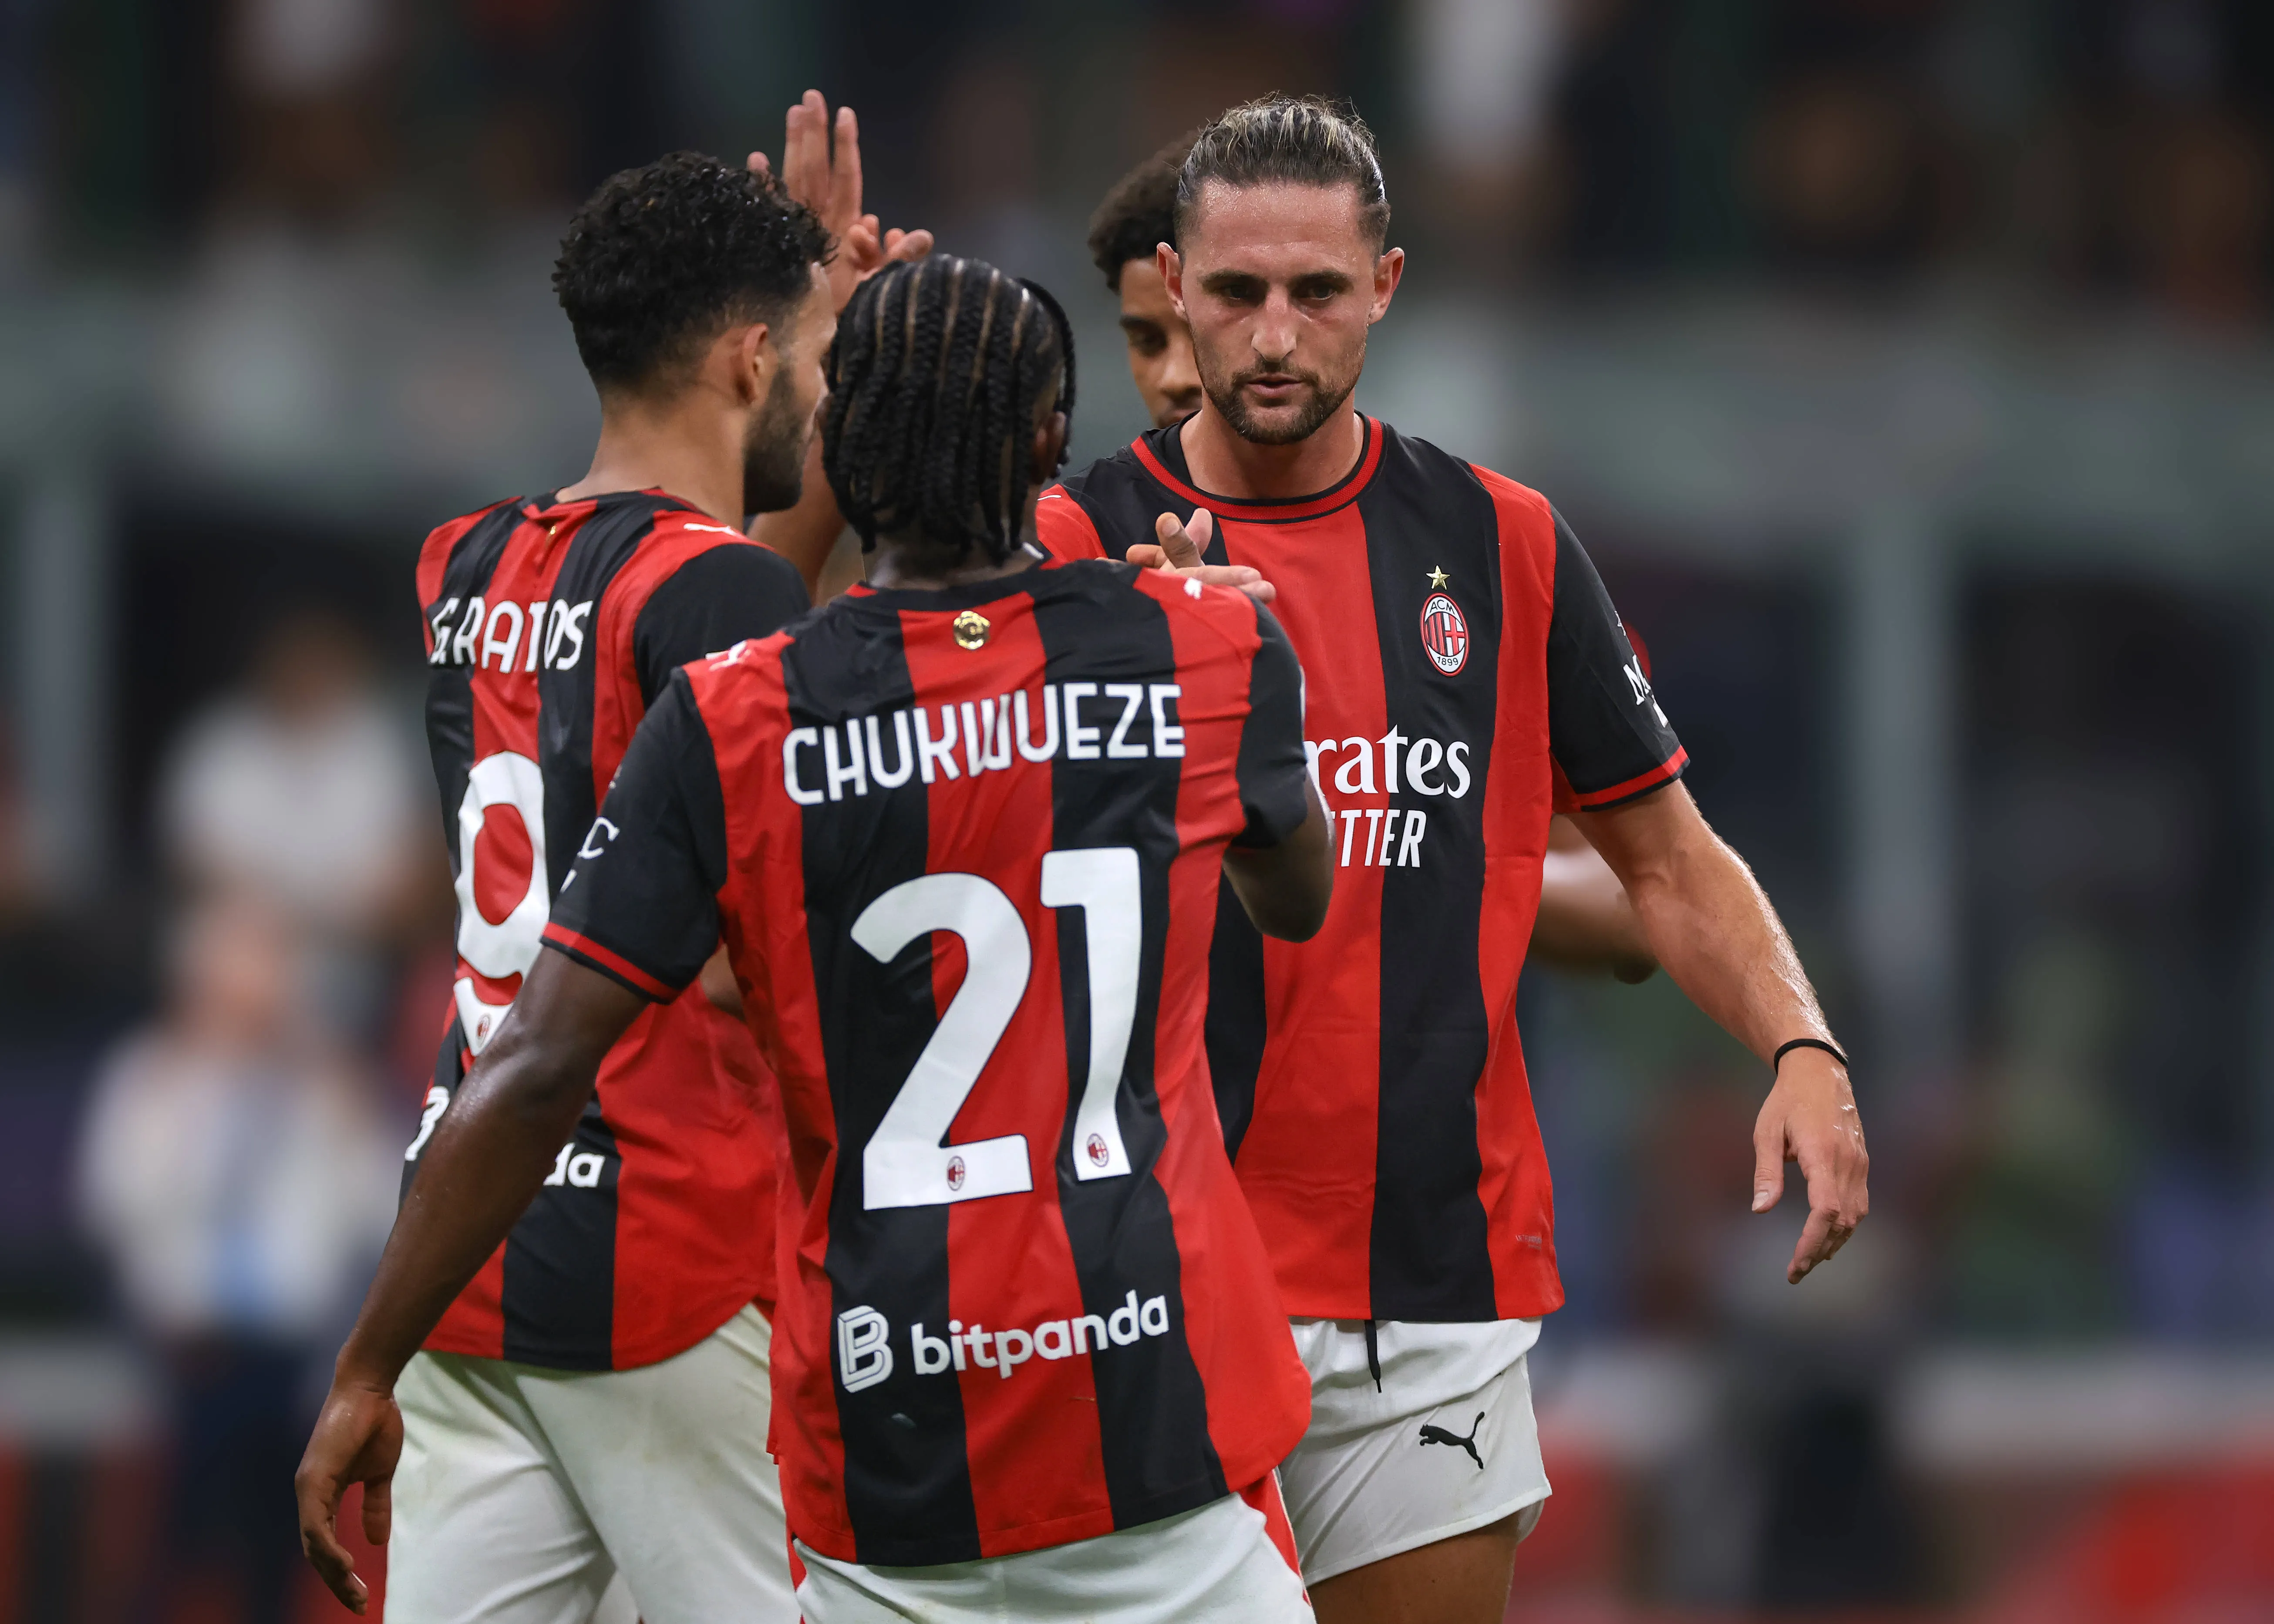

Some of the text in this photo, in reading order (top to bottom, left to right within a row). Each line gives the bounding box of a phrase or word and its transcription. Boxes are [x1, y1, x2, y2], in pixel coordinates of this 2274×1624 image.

[1429, 599, 1455, 615] ACM
[1436, 657, 1459, 666] 1899
[783, 682, 1186, 805] CHUKWUEZE
[1304, 724, 1471, 799] rates
[1331, 809, 1427, 868] TTER
[453, 750, 551, 1057] 9
[850, 846, 1143, 1211] 21
[911, 1289, 1169, 1379] bitpanda
